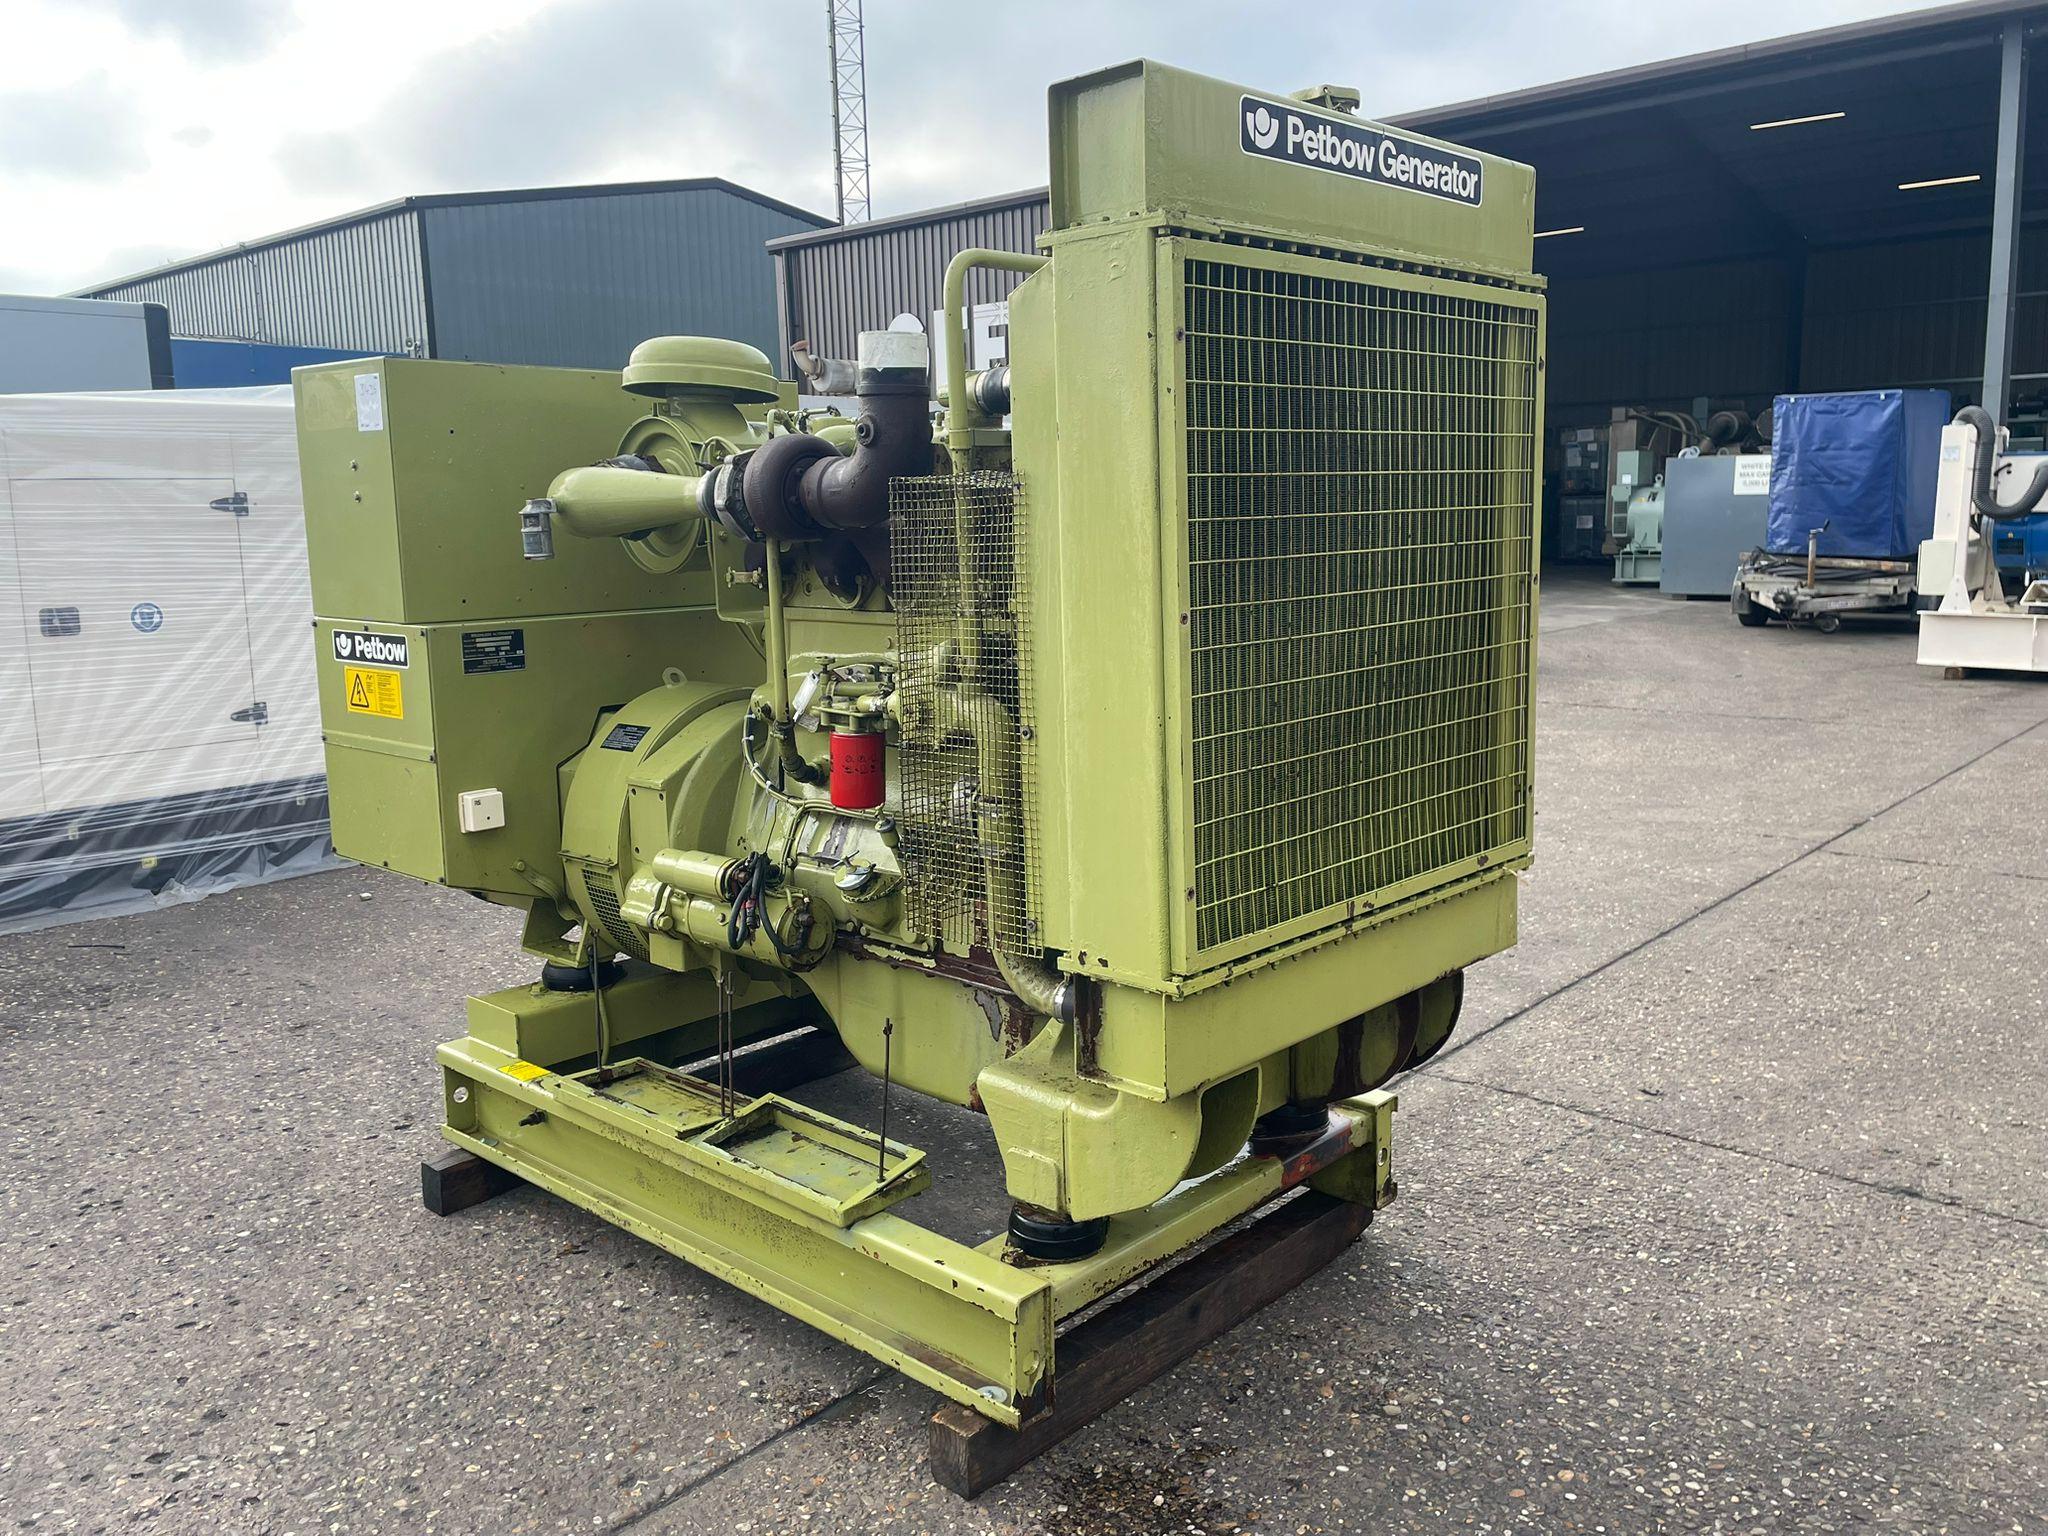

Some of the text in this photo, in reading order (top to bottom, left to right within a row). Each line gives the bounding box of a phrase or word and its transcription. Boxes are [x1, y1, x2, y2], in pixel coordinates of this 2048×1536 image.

[1287, 115, 1478, 198] Petbow Generator
[354, 635, 405, 661] Petbow
